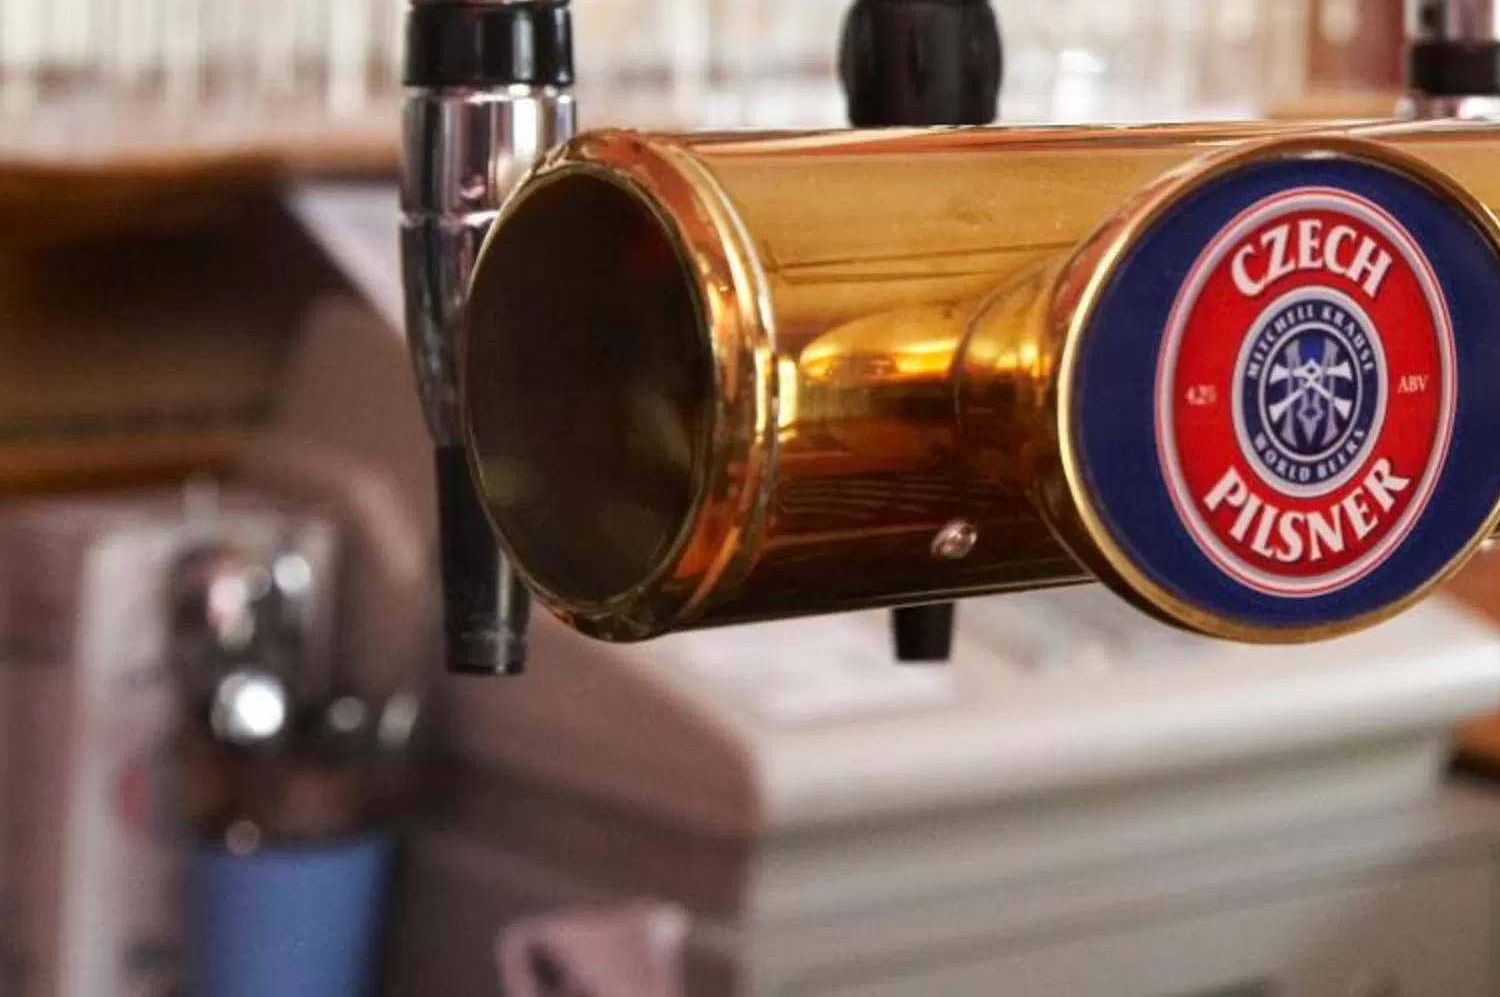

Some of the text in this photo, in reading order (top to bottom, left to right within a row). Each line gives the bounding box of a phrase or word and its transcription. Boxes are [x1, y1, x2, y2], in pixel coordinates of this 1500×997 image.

[1230, 218, 1394, 299] CZECH
[1398, 374, 1430, 393] ABV
[1254, 432, 1311, 481] WORLD
[1204, 457, 1411, 564] PILSNER
